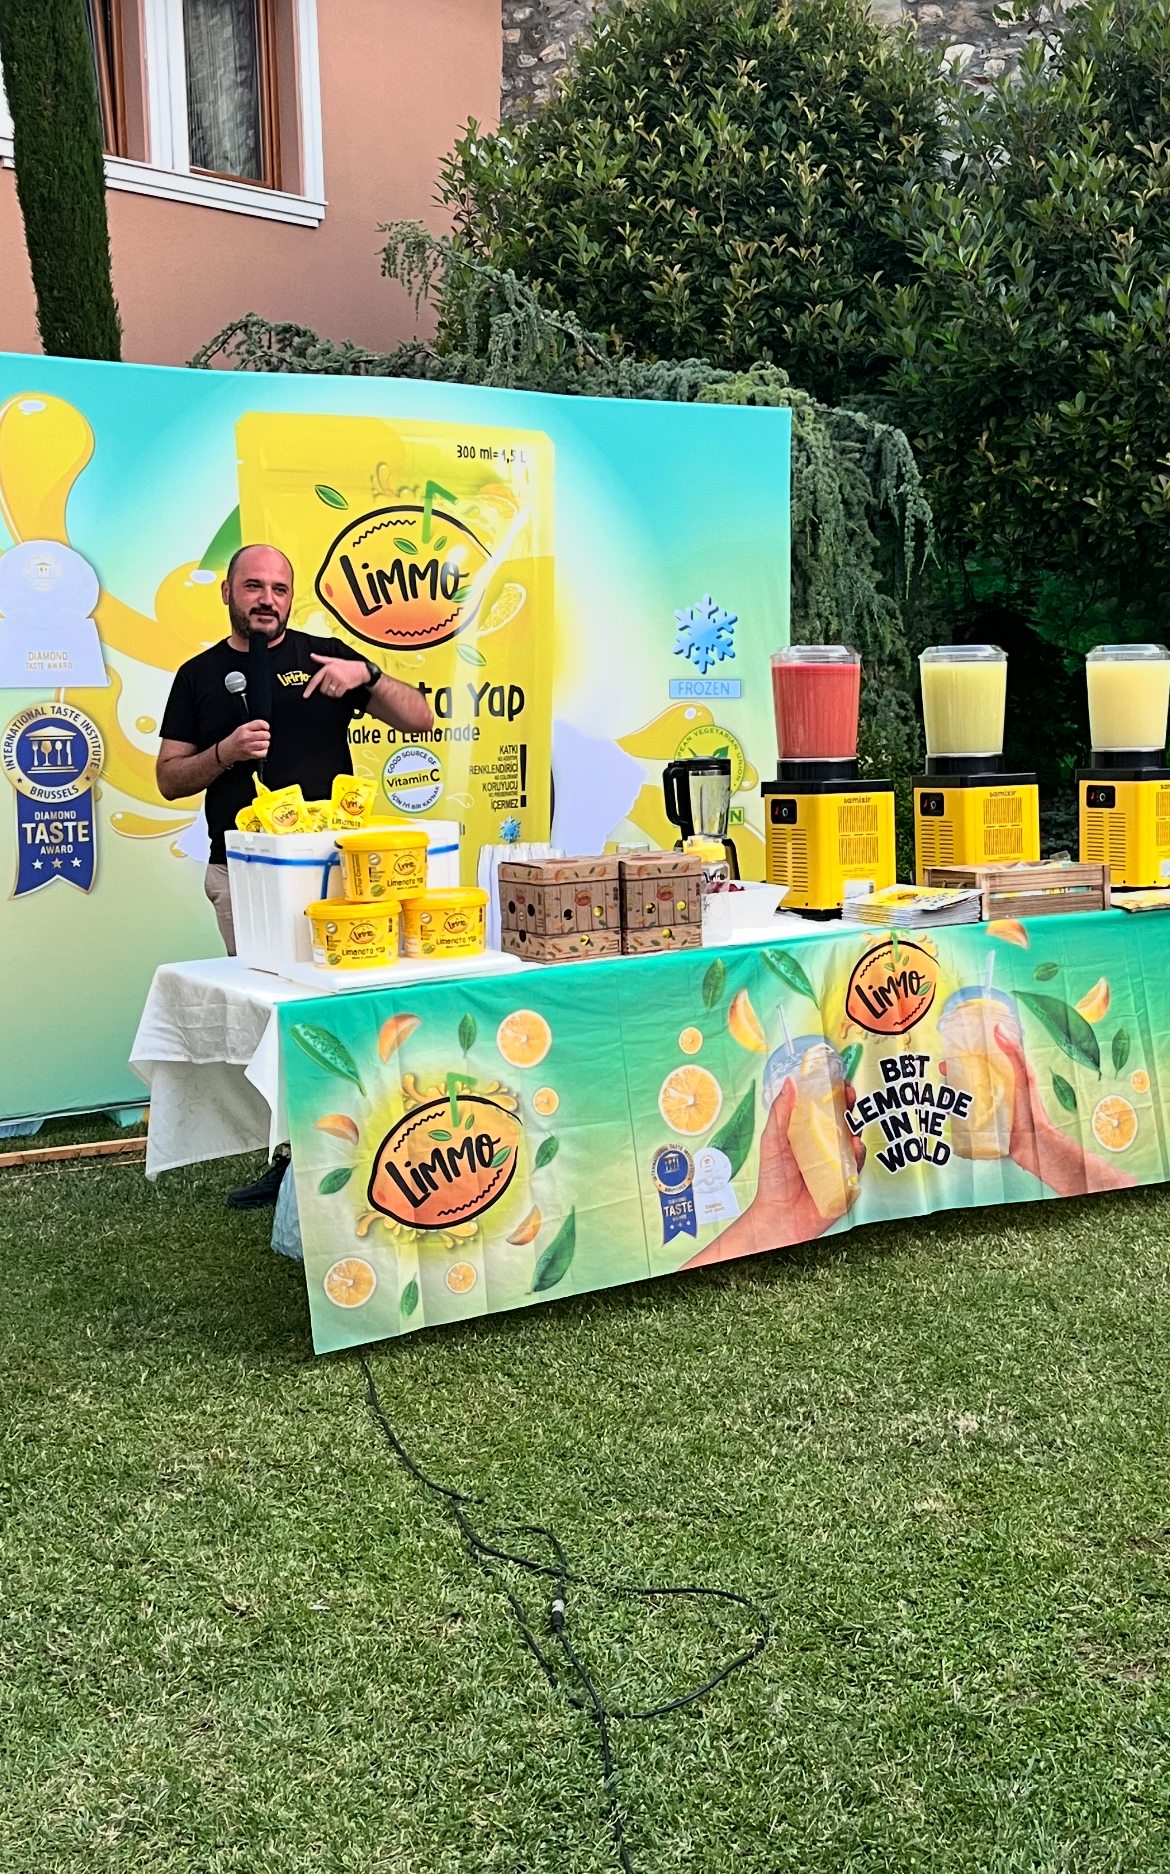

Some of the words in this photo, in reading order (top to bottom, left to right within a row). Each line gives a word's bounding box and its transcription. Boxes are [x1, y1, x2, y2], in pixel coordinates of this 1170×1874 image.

[456, 444, 476, 459] 300
[28, 651, 68, 661] DIAMOND
[678, 682, 730, 696] FROZEN
[466, 681, 525, 722] Yap
[3, 706, 47, 771] INTERNATIONAL
[50, 705, 81, 722] TASTE
[80, 719, 102, 769] INSTITUTE
[347, 725, 381, 744] ake
[387, 728, 396, 744] a
[499, 745, 518, 755] KATKI
[693, 727, 739, 751] VEGETARIAN
[735, 753, 743, 782] UNION
[387, 755, 402, 774] GOOD
[401, 750, 428, 759] SOURCE
[427, 757, 437, 765] OF
[386, 773, 429, 788] Vitamin
[429, 768, 441, 782] C
[482, 780, 519, 792] KORUYUCU
[29, 784, 79, 799] BRUSSELS
[843, 795, 872, 804] samixir
[989, 789, 1017, 798] samixir
[34, 810, 77, 821] DIAMOND
[21, 820, 90, 845] TASTE
[40, 844, 74, 855] AWARD
[879, 1053, 930, 1083] BEST
[879, 1111, 914, 1142] IN
[915, 1108, 946, 1137] HE
[876, 1136, 951, 1173] WOLD
[663, 1200, 694, 1218] TASTE
